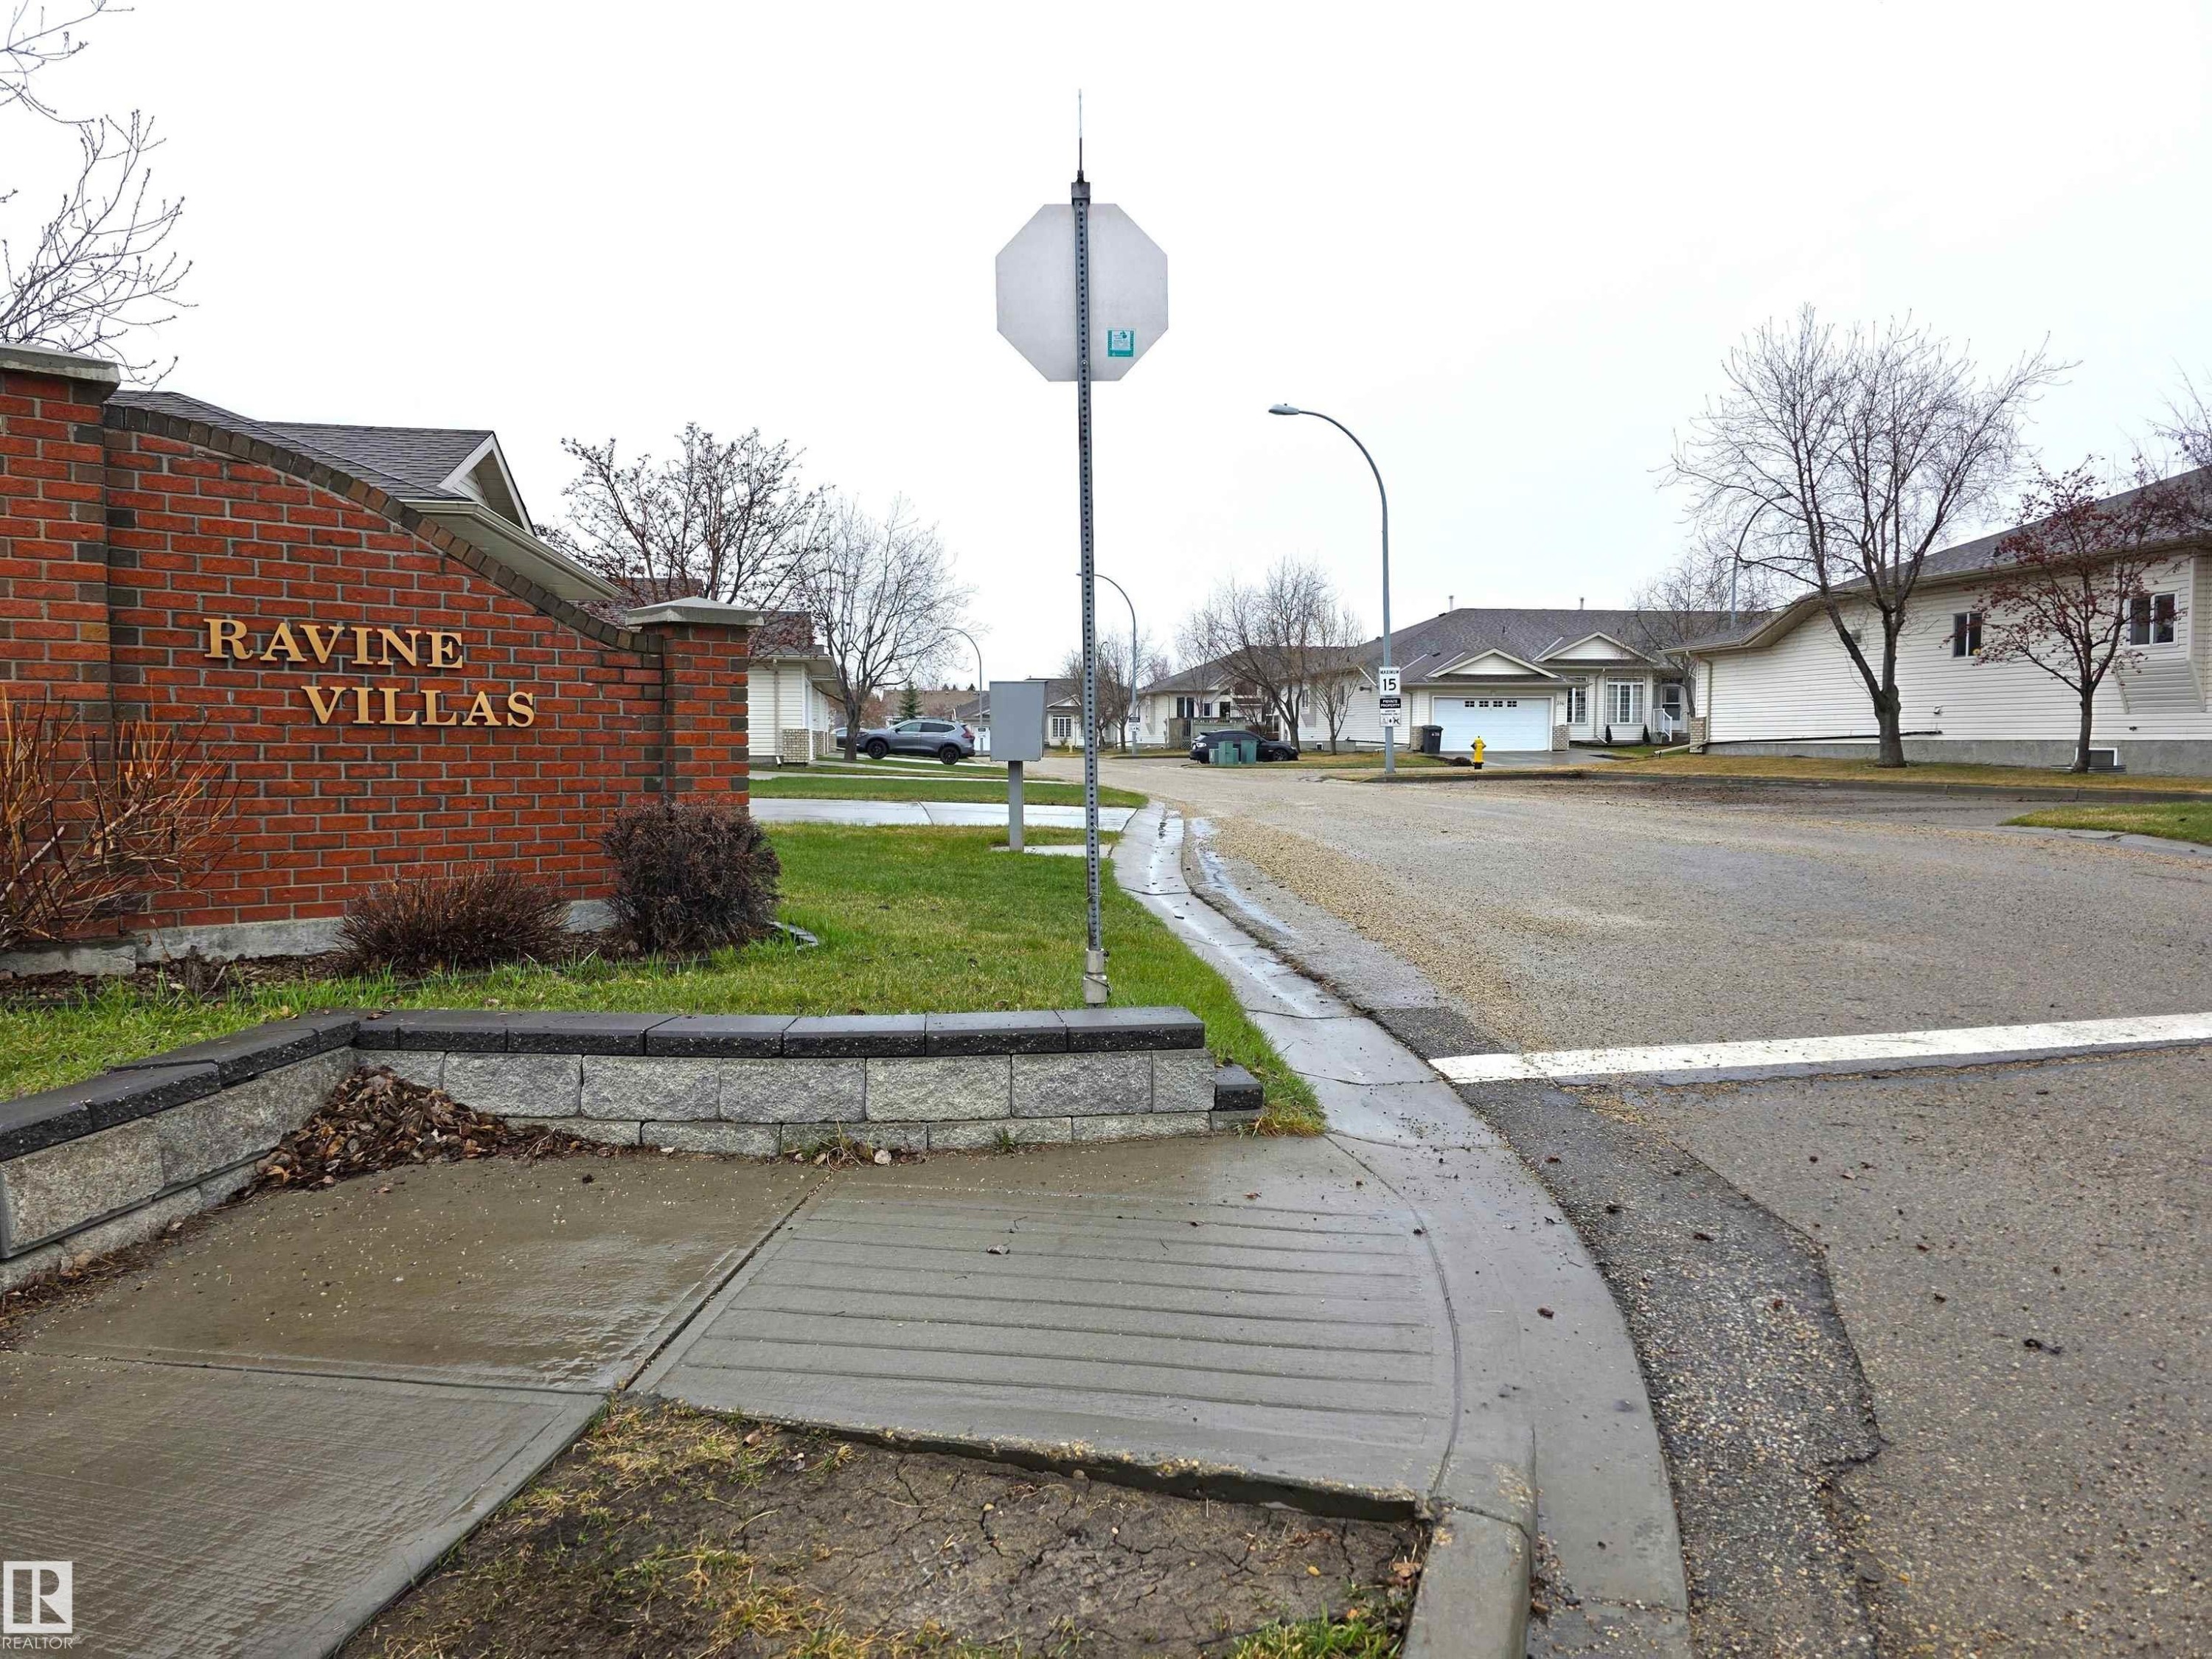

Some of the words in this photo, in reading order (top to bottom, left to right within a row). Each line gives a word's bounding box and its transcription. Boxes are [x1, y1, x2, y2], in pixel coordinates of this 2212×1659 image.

[203, 617, 463, 669] RAVINE
[1382, 678, 1397, 691] 15
[301, 685, 535, 728] VILLAS
